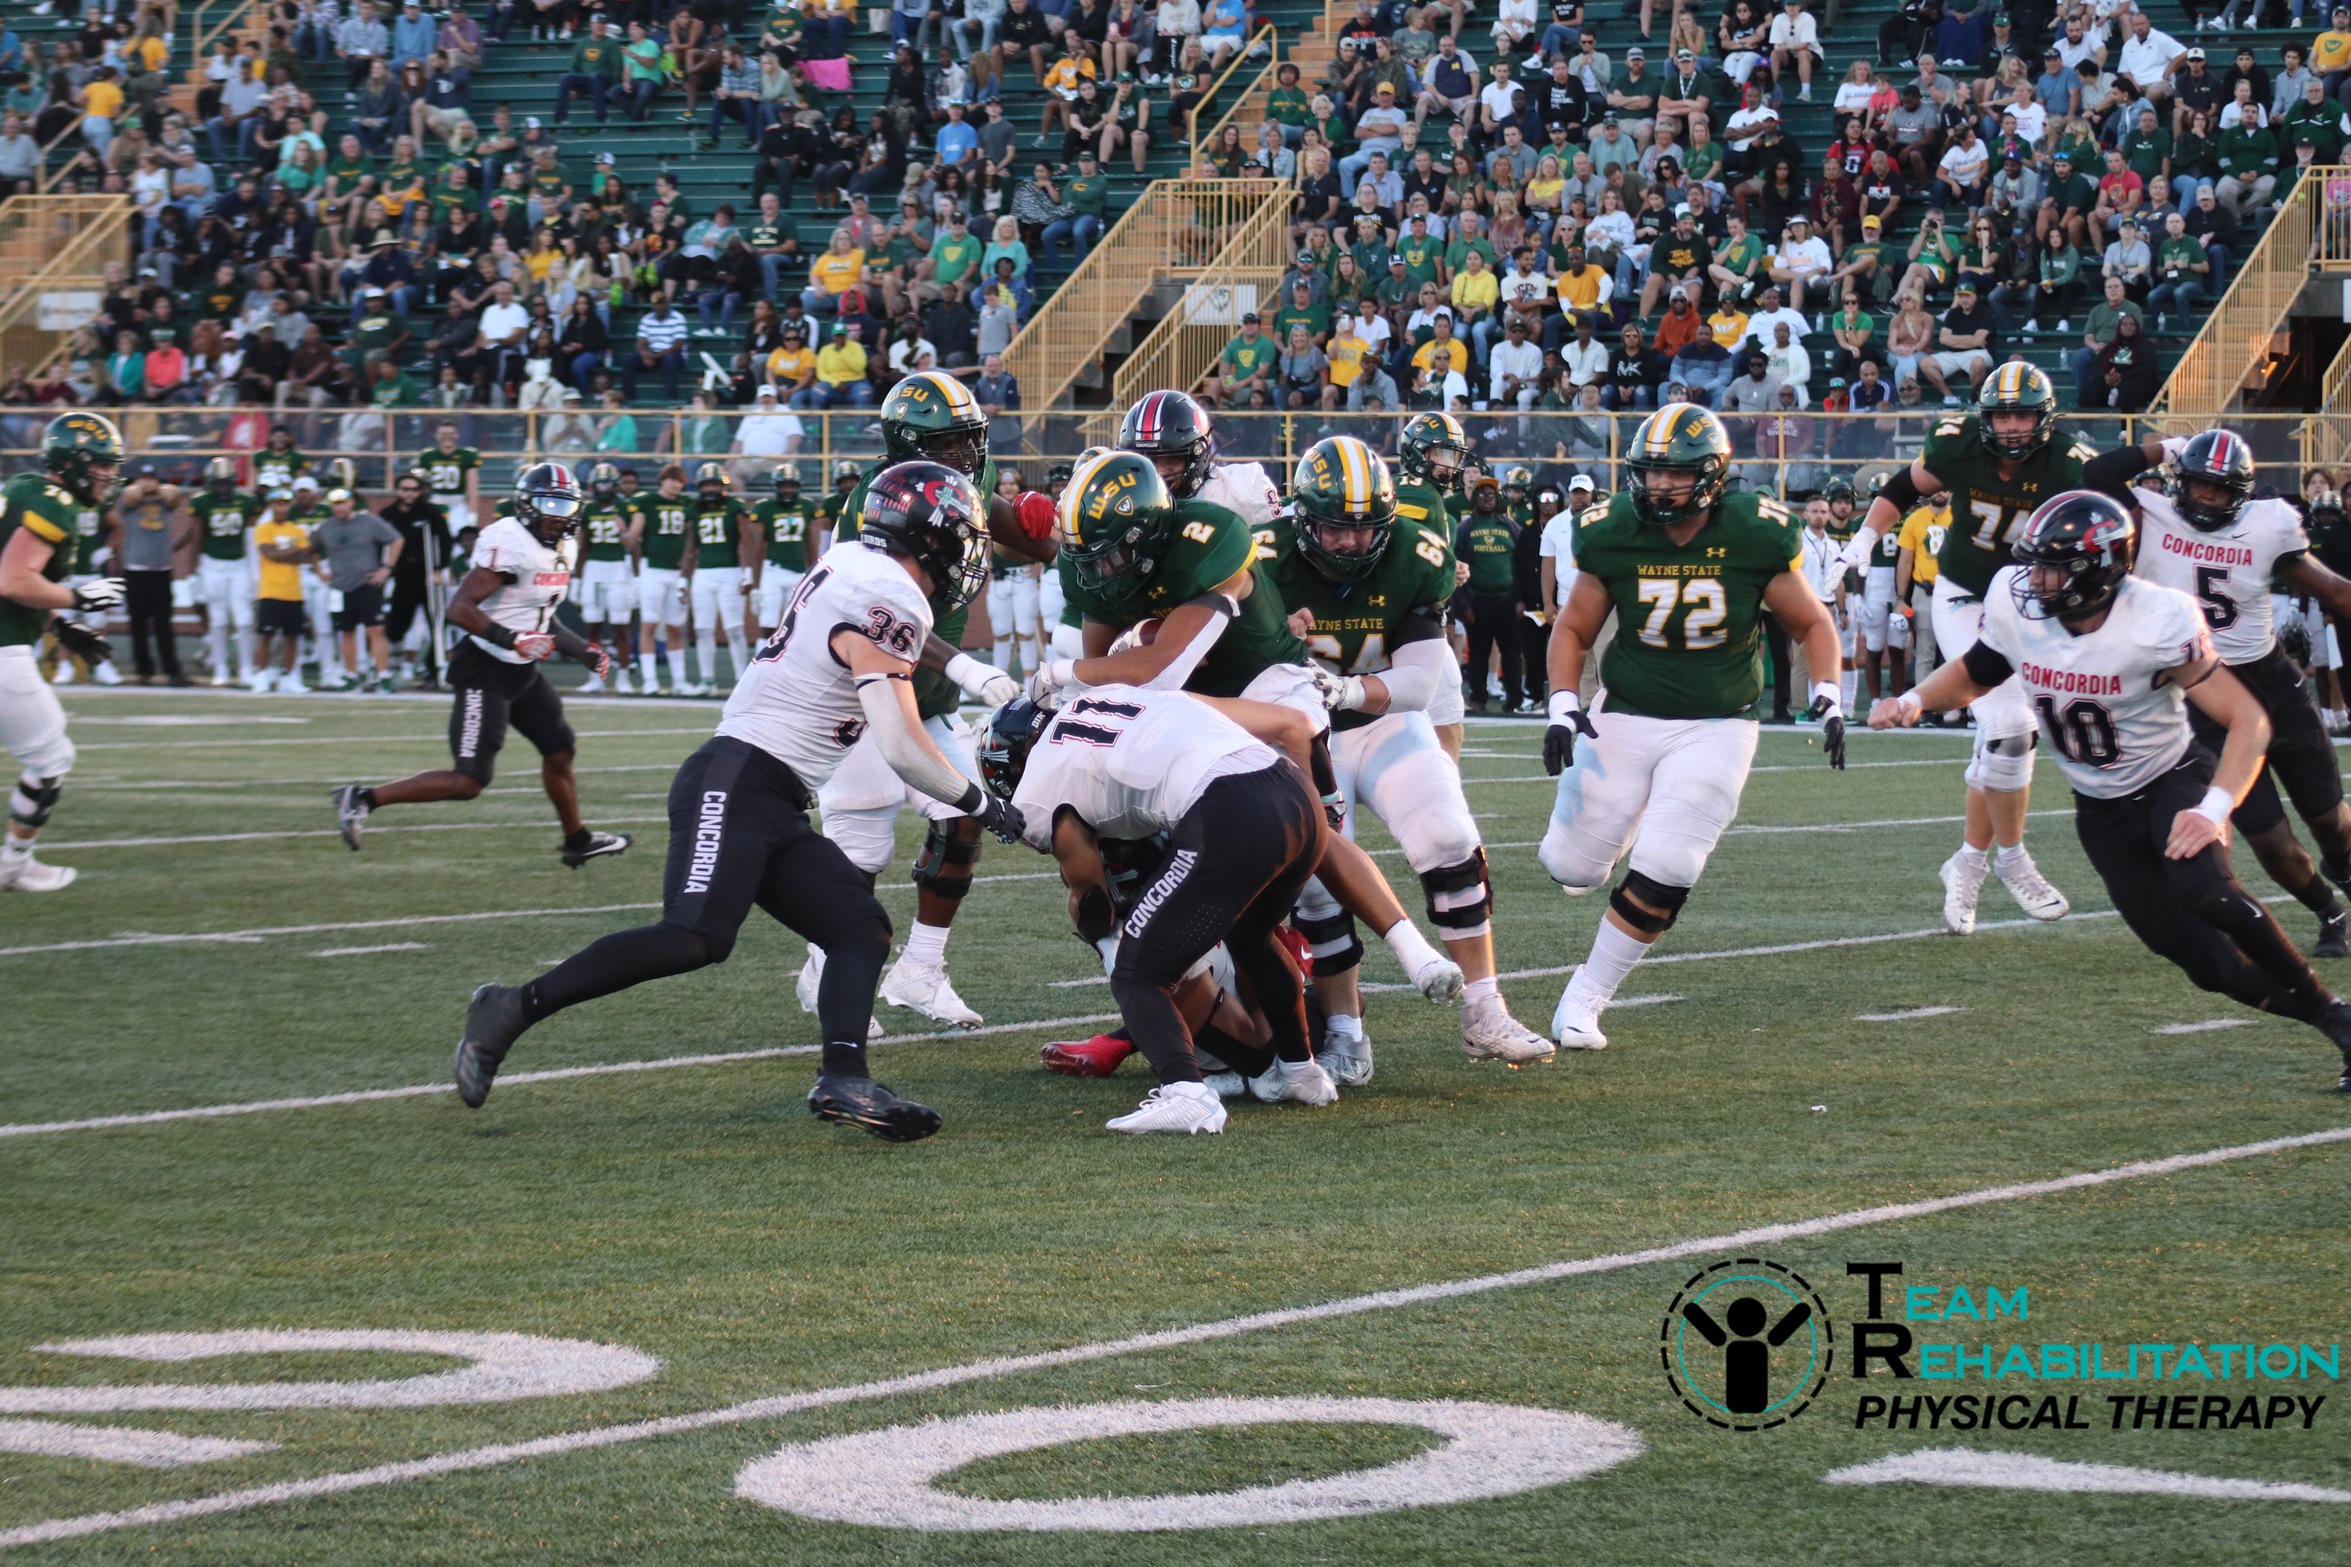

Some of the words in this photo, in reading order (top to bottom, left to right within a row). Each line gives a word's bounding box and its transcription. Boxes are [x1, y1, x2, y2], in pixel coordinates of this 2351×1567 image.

[885, 385, 930, 403] WSU
[1685, 417, 1714, 438] WS
[430, 465, 460, 489] 20
[1305, 449, 1332, 490] WSU
[1087, 473, 1137, 520] WSU
[1969, 487, 2003, 504] WAYNE
[2003, 497, 2034, 509] STATE
[587, 521, 621, 544] 32
[658, 511, 686, 535] 18
[698, 517, 727, 544] 21
[773, 516, 806, 542] 27
[1181, 521, 1216, 544] 2
[864, 534, 888, 548] BIRDS
[1473, 544, 1506, 553] FOOTBALL
[2161, 533, 2253, 566] CONCORDIA
[1637, 565, 1680, 576] WAYNE
[1682, 565, 1722, 576] STATE
[2193, 563, 2241, 634] 5
[1306, 619, 1342, 631] AYNE
[1345, 618, 1385, 630] STATE
[1637, 578, 1728, 650] 72
[861, 606, 918, 655] 36
[2021, 661, 2122, 696] CONCORDIA
[1031, 711, 1047, 729] DIR
[1049, 696, 1147, 748] 11
[2033, 693, 2124, 770] 10
[684, 790, 728, 894] CONCORDIA
[1124, 848, 1198, 940] CONCORDIA
